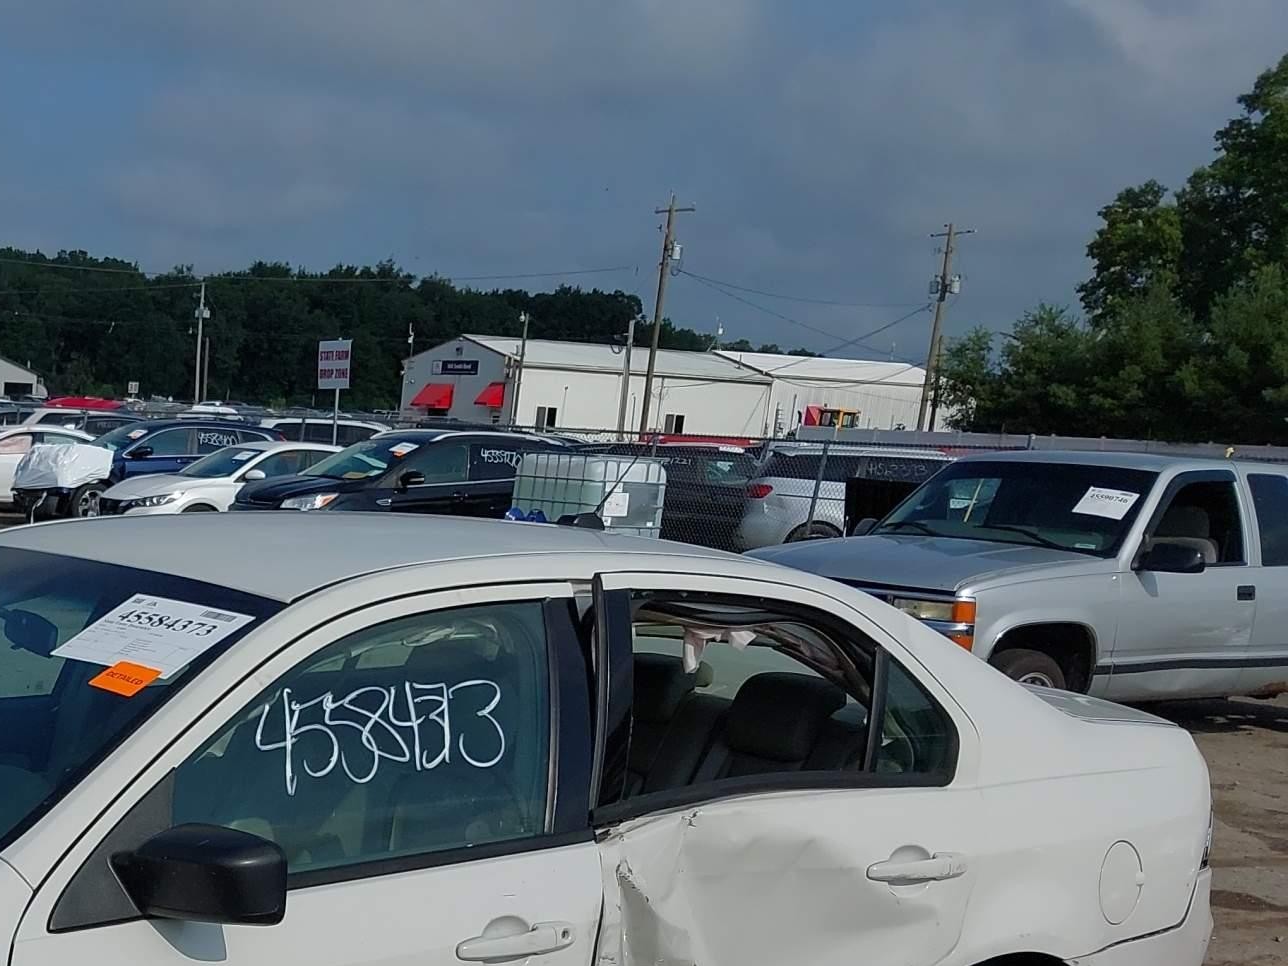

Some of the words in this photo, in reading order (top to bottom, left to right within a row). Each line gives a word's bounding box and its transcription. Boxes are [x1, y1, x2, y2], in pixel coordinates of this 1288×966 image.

[118, 608, 218, 638] 45584373
[105, 670, 144, 686] DETAILED
[255, 679, 505, 797] 45584373
